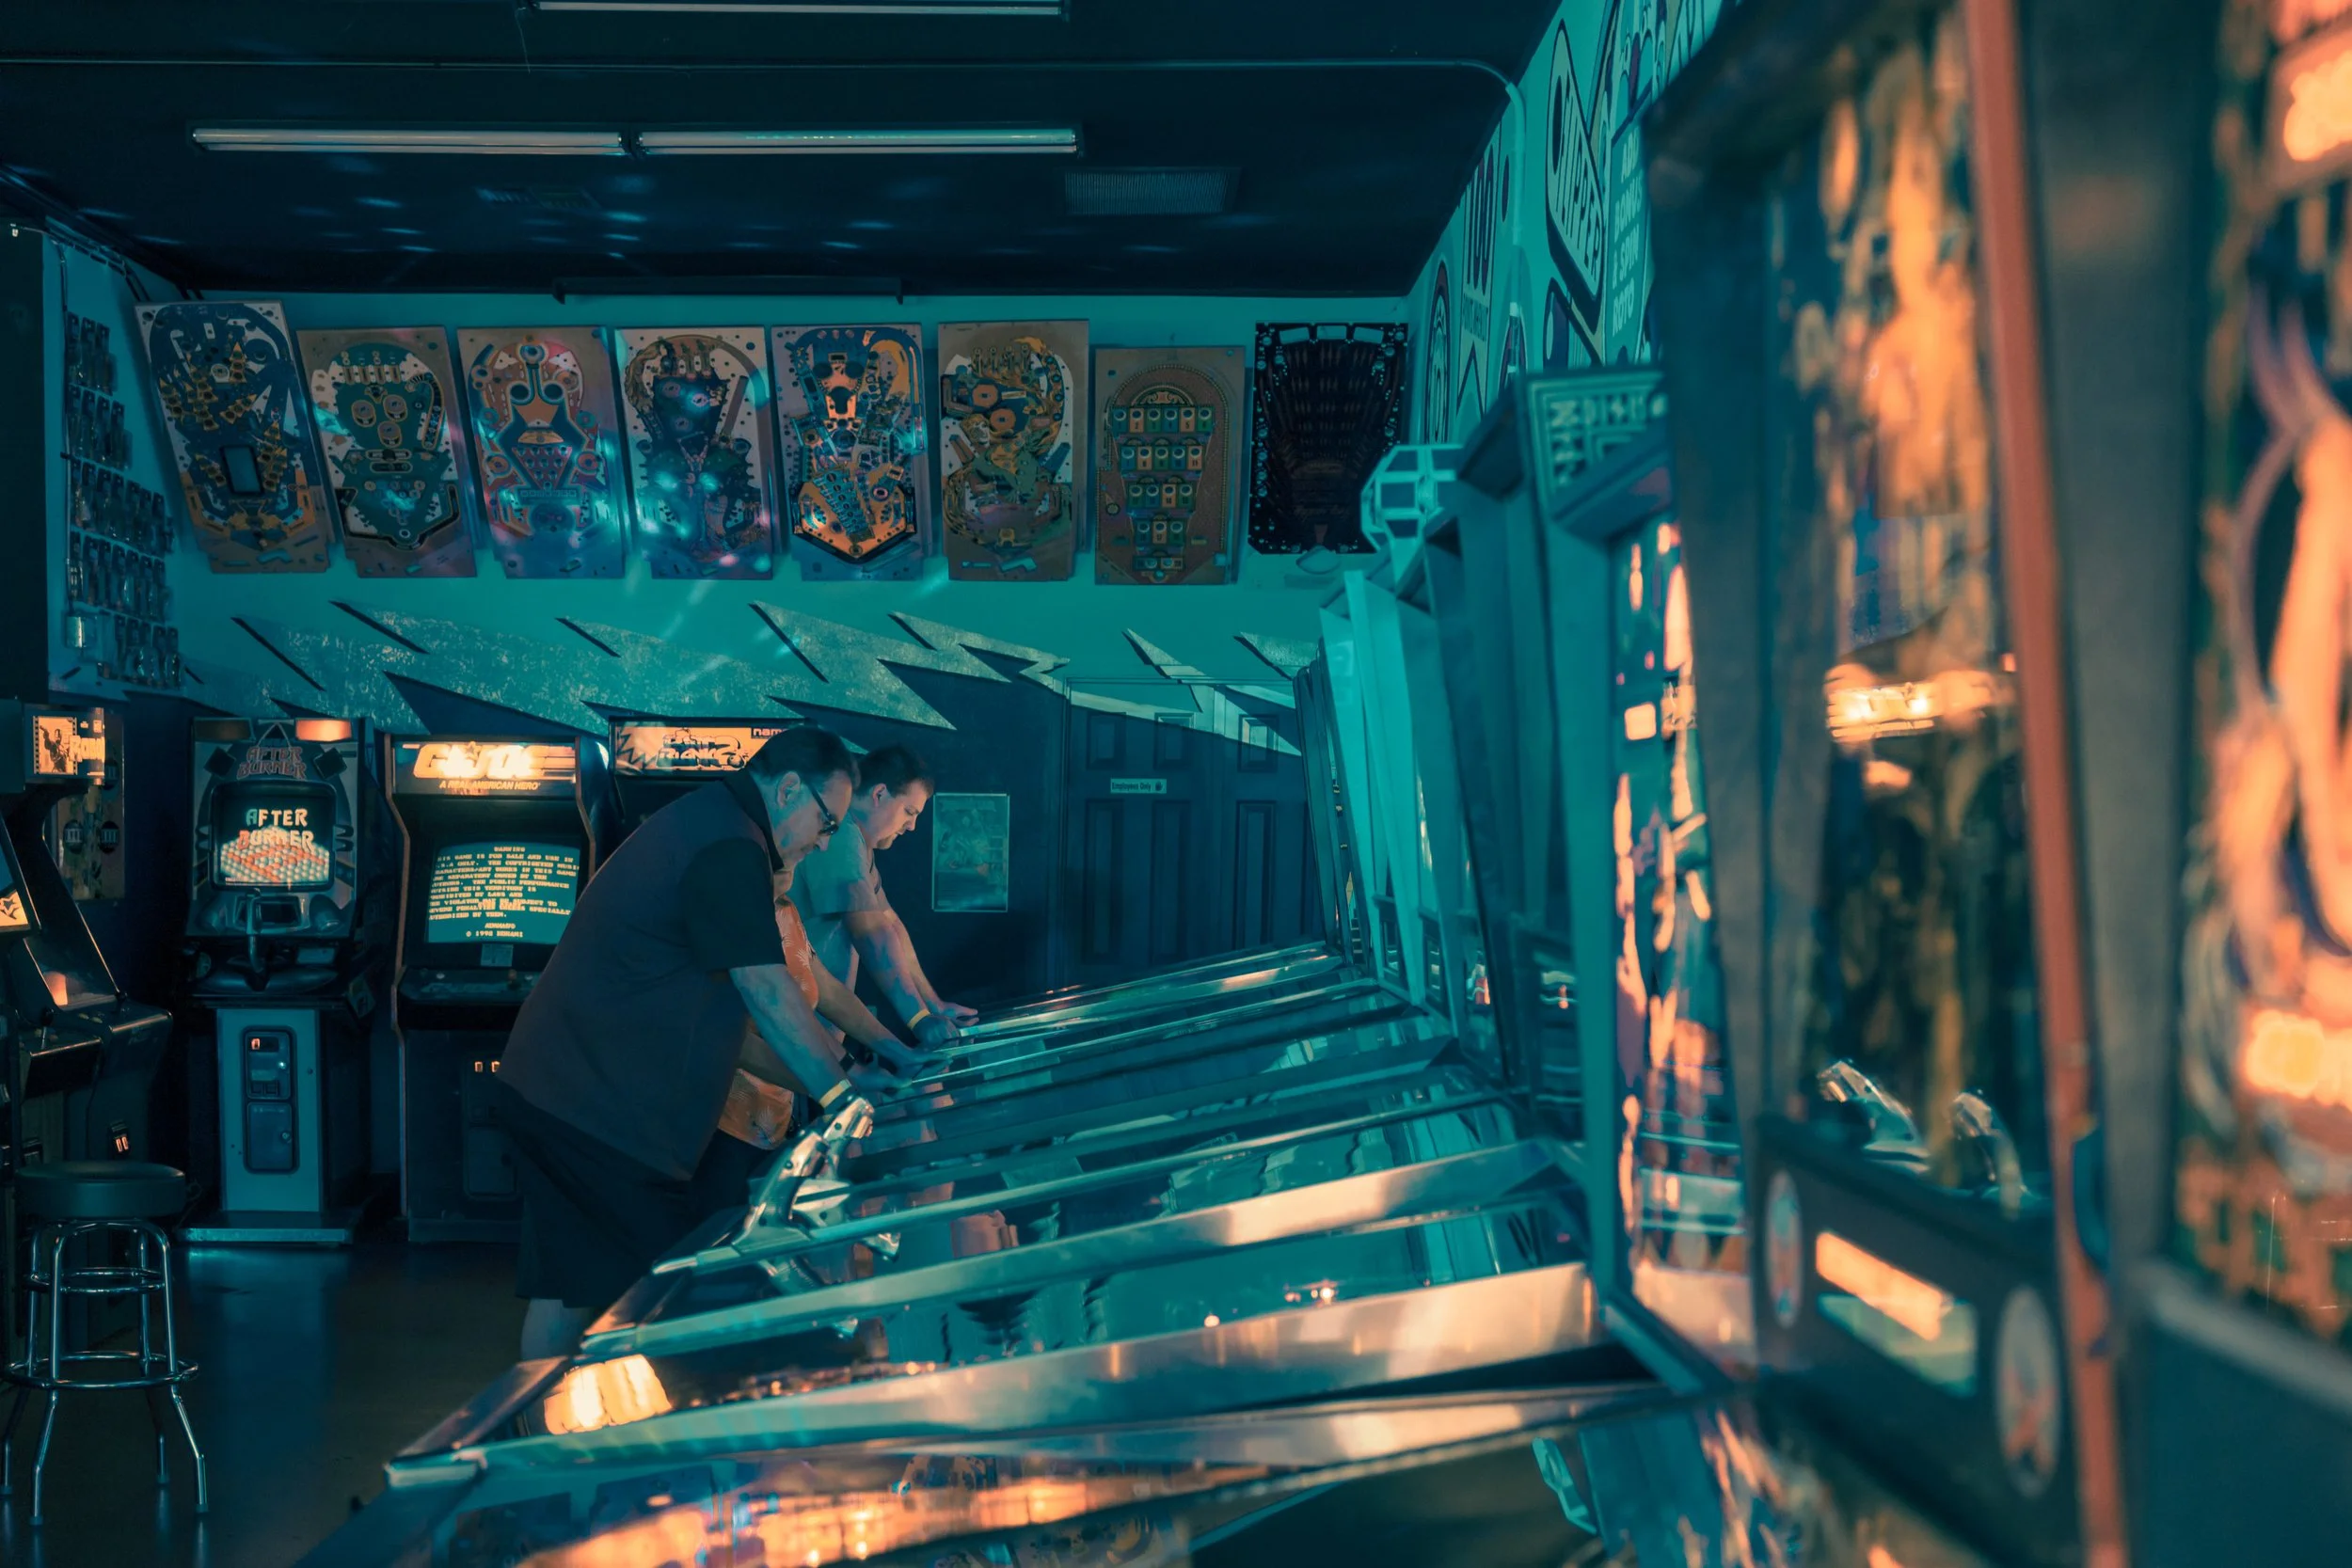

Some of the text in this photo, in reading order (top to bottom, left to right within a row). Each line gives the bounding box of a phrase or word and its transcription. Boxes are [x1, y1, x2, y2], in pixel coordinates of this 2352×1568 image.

[1620, 126, 1640, 183] ADD
[1614, 167, 1643, 245] BONUS
[1619, 224, 1640, 284] SPIN
[1612, 277, 1635, 338] ROTO
[69, 735, 104, 762] ROBO
[246, 746, 303, 762] AFTER
[236, 759, 307, 781] BURNER
[448, 781, 470, 789] REAL
[471, 781, 515, 790] AMERICAN
[514, 782, 539, 790] HERO
[1140, 782, 1151, 792] Only
[246, 808, 308, 827] AFTER
[236, 830, 314, 852] BURNER
[518, 879, 570, 889] PERFORMANCE
[529, 906, 571, 915] SPECIALLY
